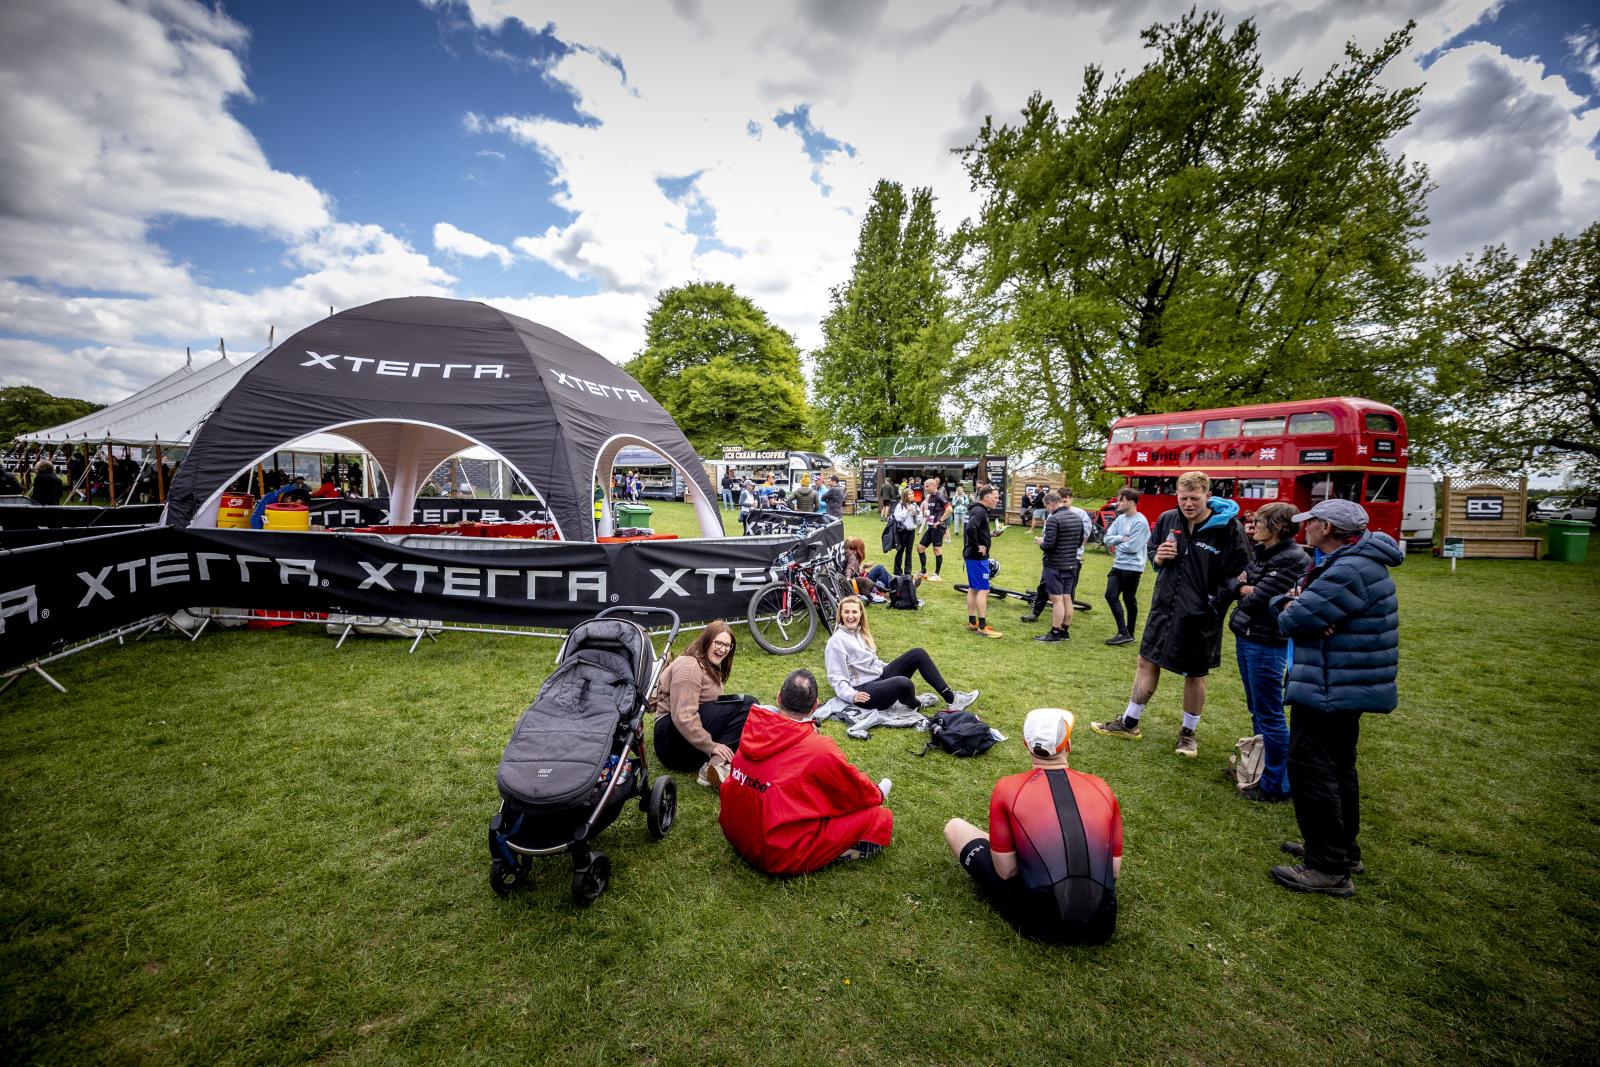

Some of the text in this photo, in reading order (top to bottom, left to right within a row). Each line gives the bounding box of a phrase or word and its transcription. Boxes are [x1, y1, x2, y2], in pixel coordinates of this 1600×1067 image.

[893, 437, 926, 456] Churros
[936, 436, 970, 455] Coffee
[1152, 448, 1253, 461] British Bus Bar
